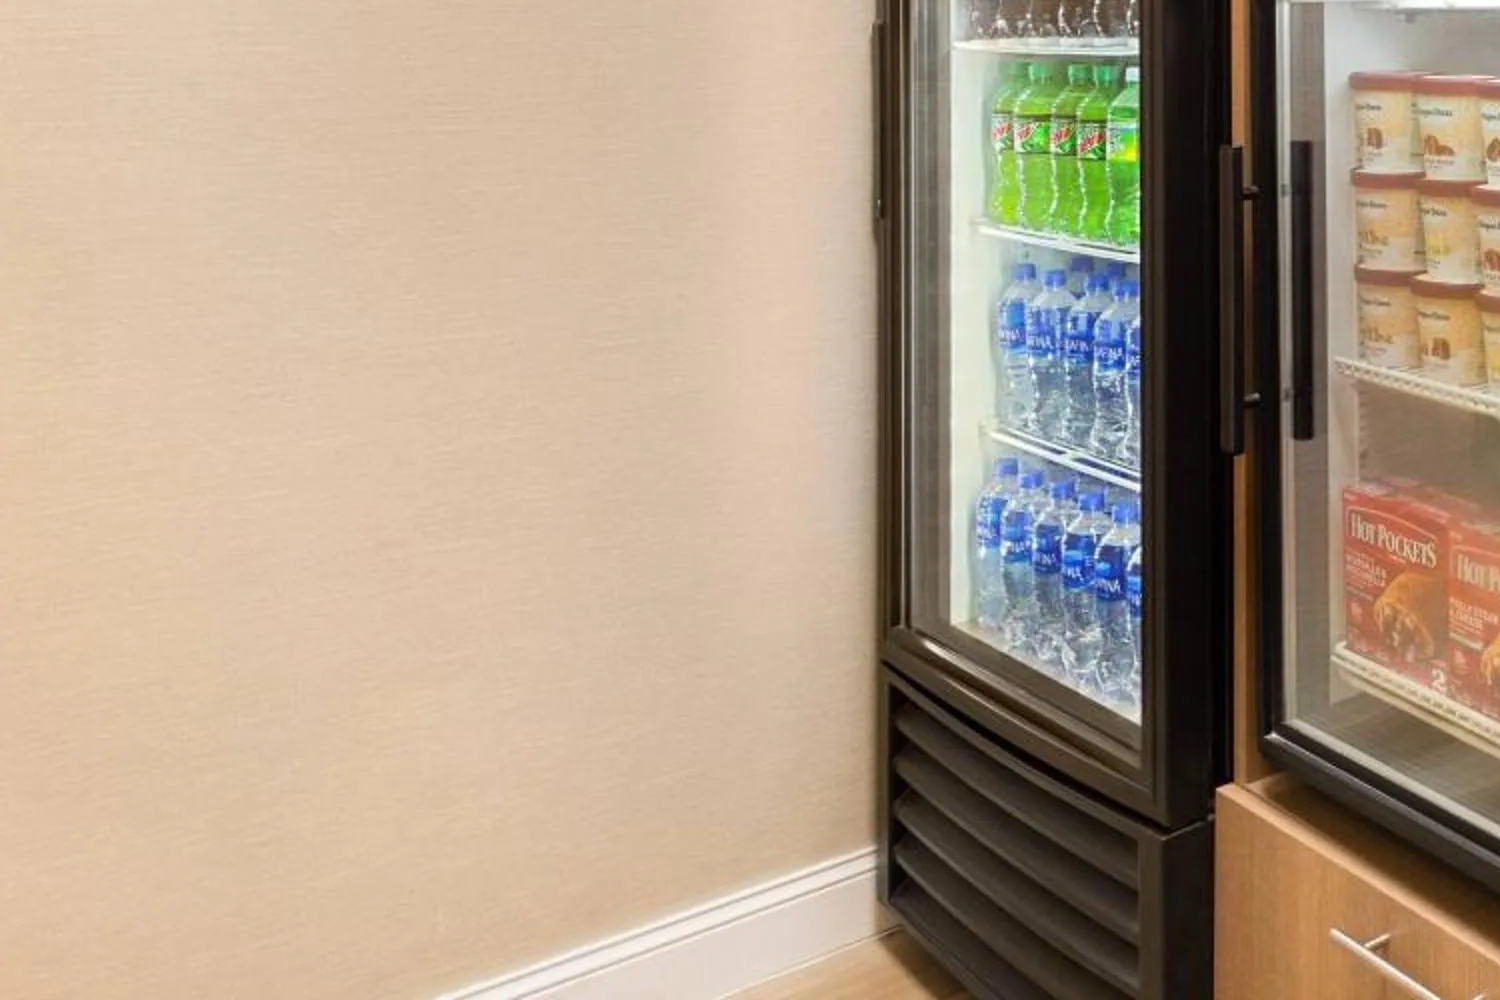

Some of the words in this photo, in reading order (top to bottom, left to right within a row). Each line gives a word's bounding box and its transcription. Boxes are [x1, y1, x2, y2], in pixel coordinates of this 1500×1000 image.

[1350, 512, 1376, 545] HOT
[1377, 523, 1438, 569] POCKETS
[1456, 553, 1486, 588] HOT
[1430, 668, 1447, 694] 2
